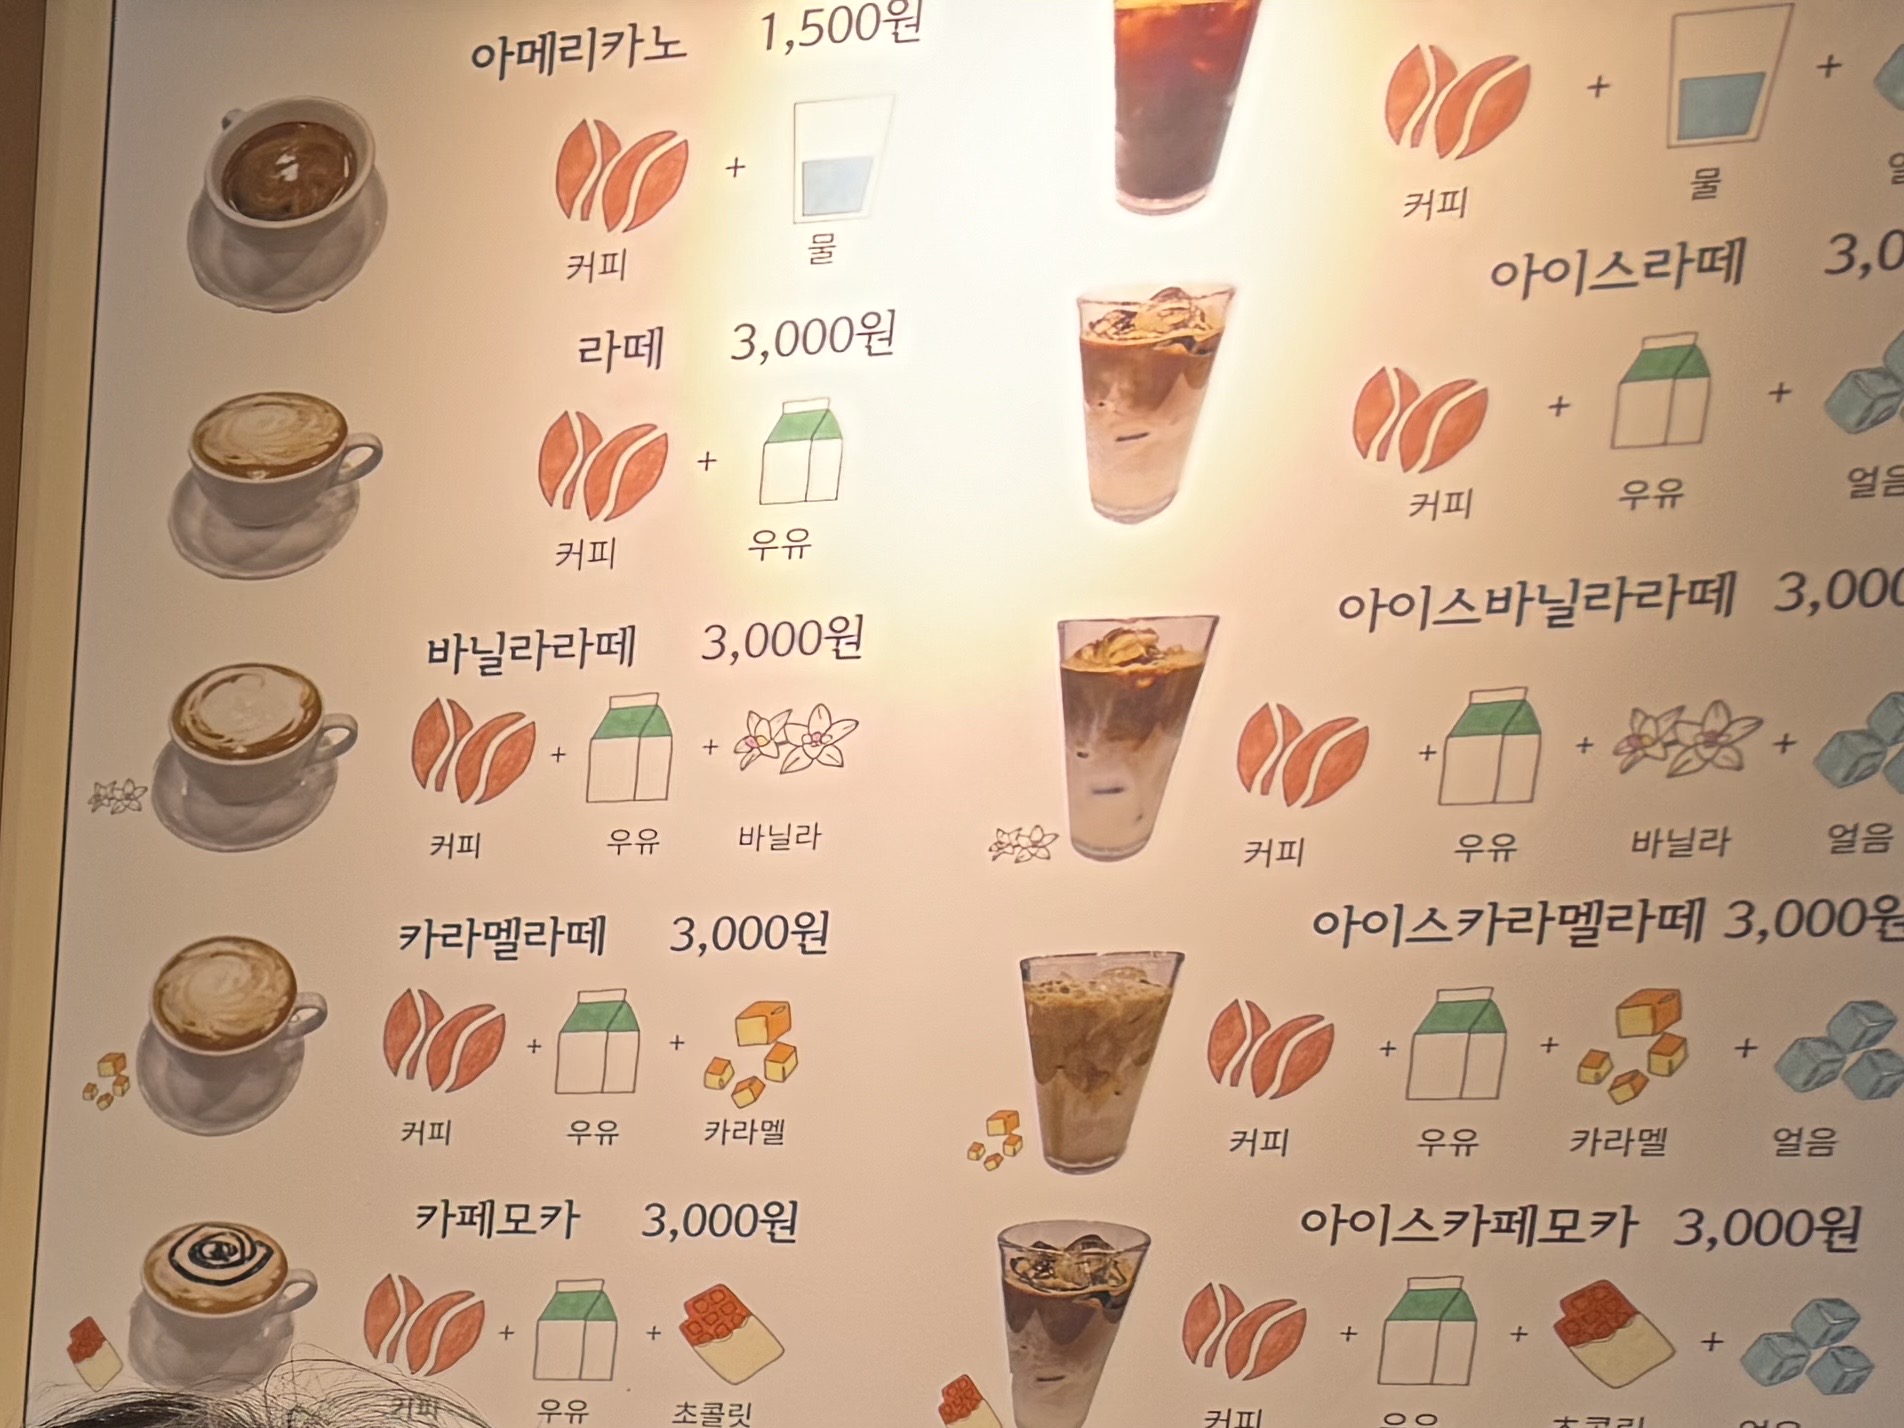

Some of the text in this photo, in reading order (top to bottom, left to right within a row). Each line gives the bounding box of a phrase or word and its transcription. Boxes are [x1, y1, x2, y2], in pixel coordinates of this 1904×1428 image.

[472, 0, 922, 81] 아메리카노 1,500원
[1403, 167, 1721, 221] 커피 물
[567, 233, 836, 283] 커피 물
[1491, 237, 1747, 300] 아이스라떼
[579, 309, 895, 373] 라떼 3,000원
[1409, 488, 1473, 521] 커피
[1619, 478, 1684, 511] 우유
[556, 528, 811, 571] 커피 우유
[1339, 571, 1736, 633] 아이스바닐라라떼
[428, 614, 863, 676] 바닐라라떼 3,000원
[430, 822, 822, 859] 커피 우유 바닐라
[1244, 823, 1894, 868] 커피 우유 바닐라 얼음
[400, 910, 829, 961] 카라멜라떼 3,000원
[1313, 898, 1706, 949] 아이스카라멜라떼
[402, 1119, 784, 1146] 커피 우유 카라멜
[1230, 1127, 1837, 1157] 커피 우유 카라멜 얼음
[417, 1199, 797, 1243] 카페모카 3,000원
[1301, 1204, 1862, 1253] 아이스카페모카 3,000원
[537, 1399, 589, 1424] 우유
[672, 1402, 751, 1428] 초콜릿
